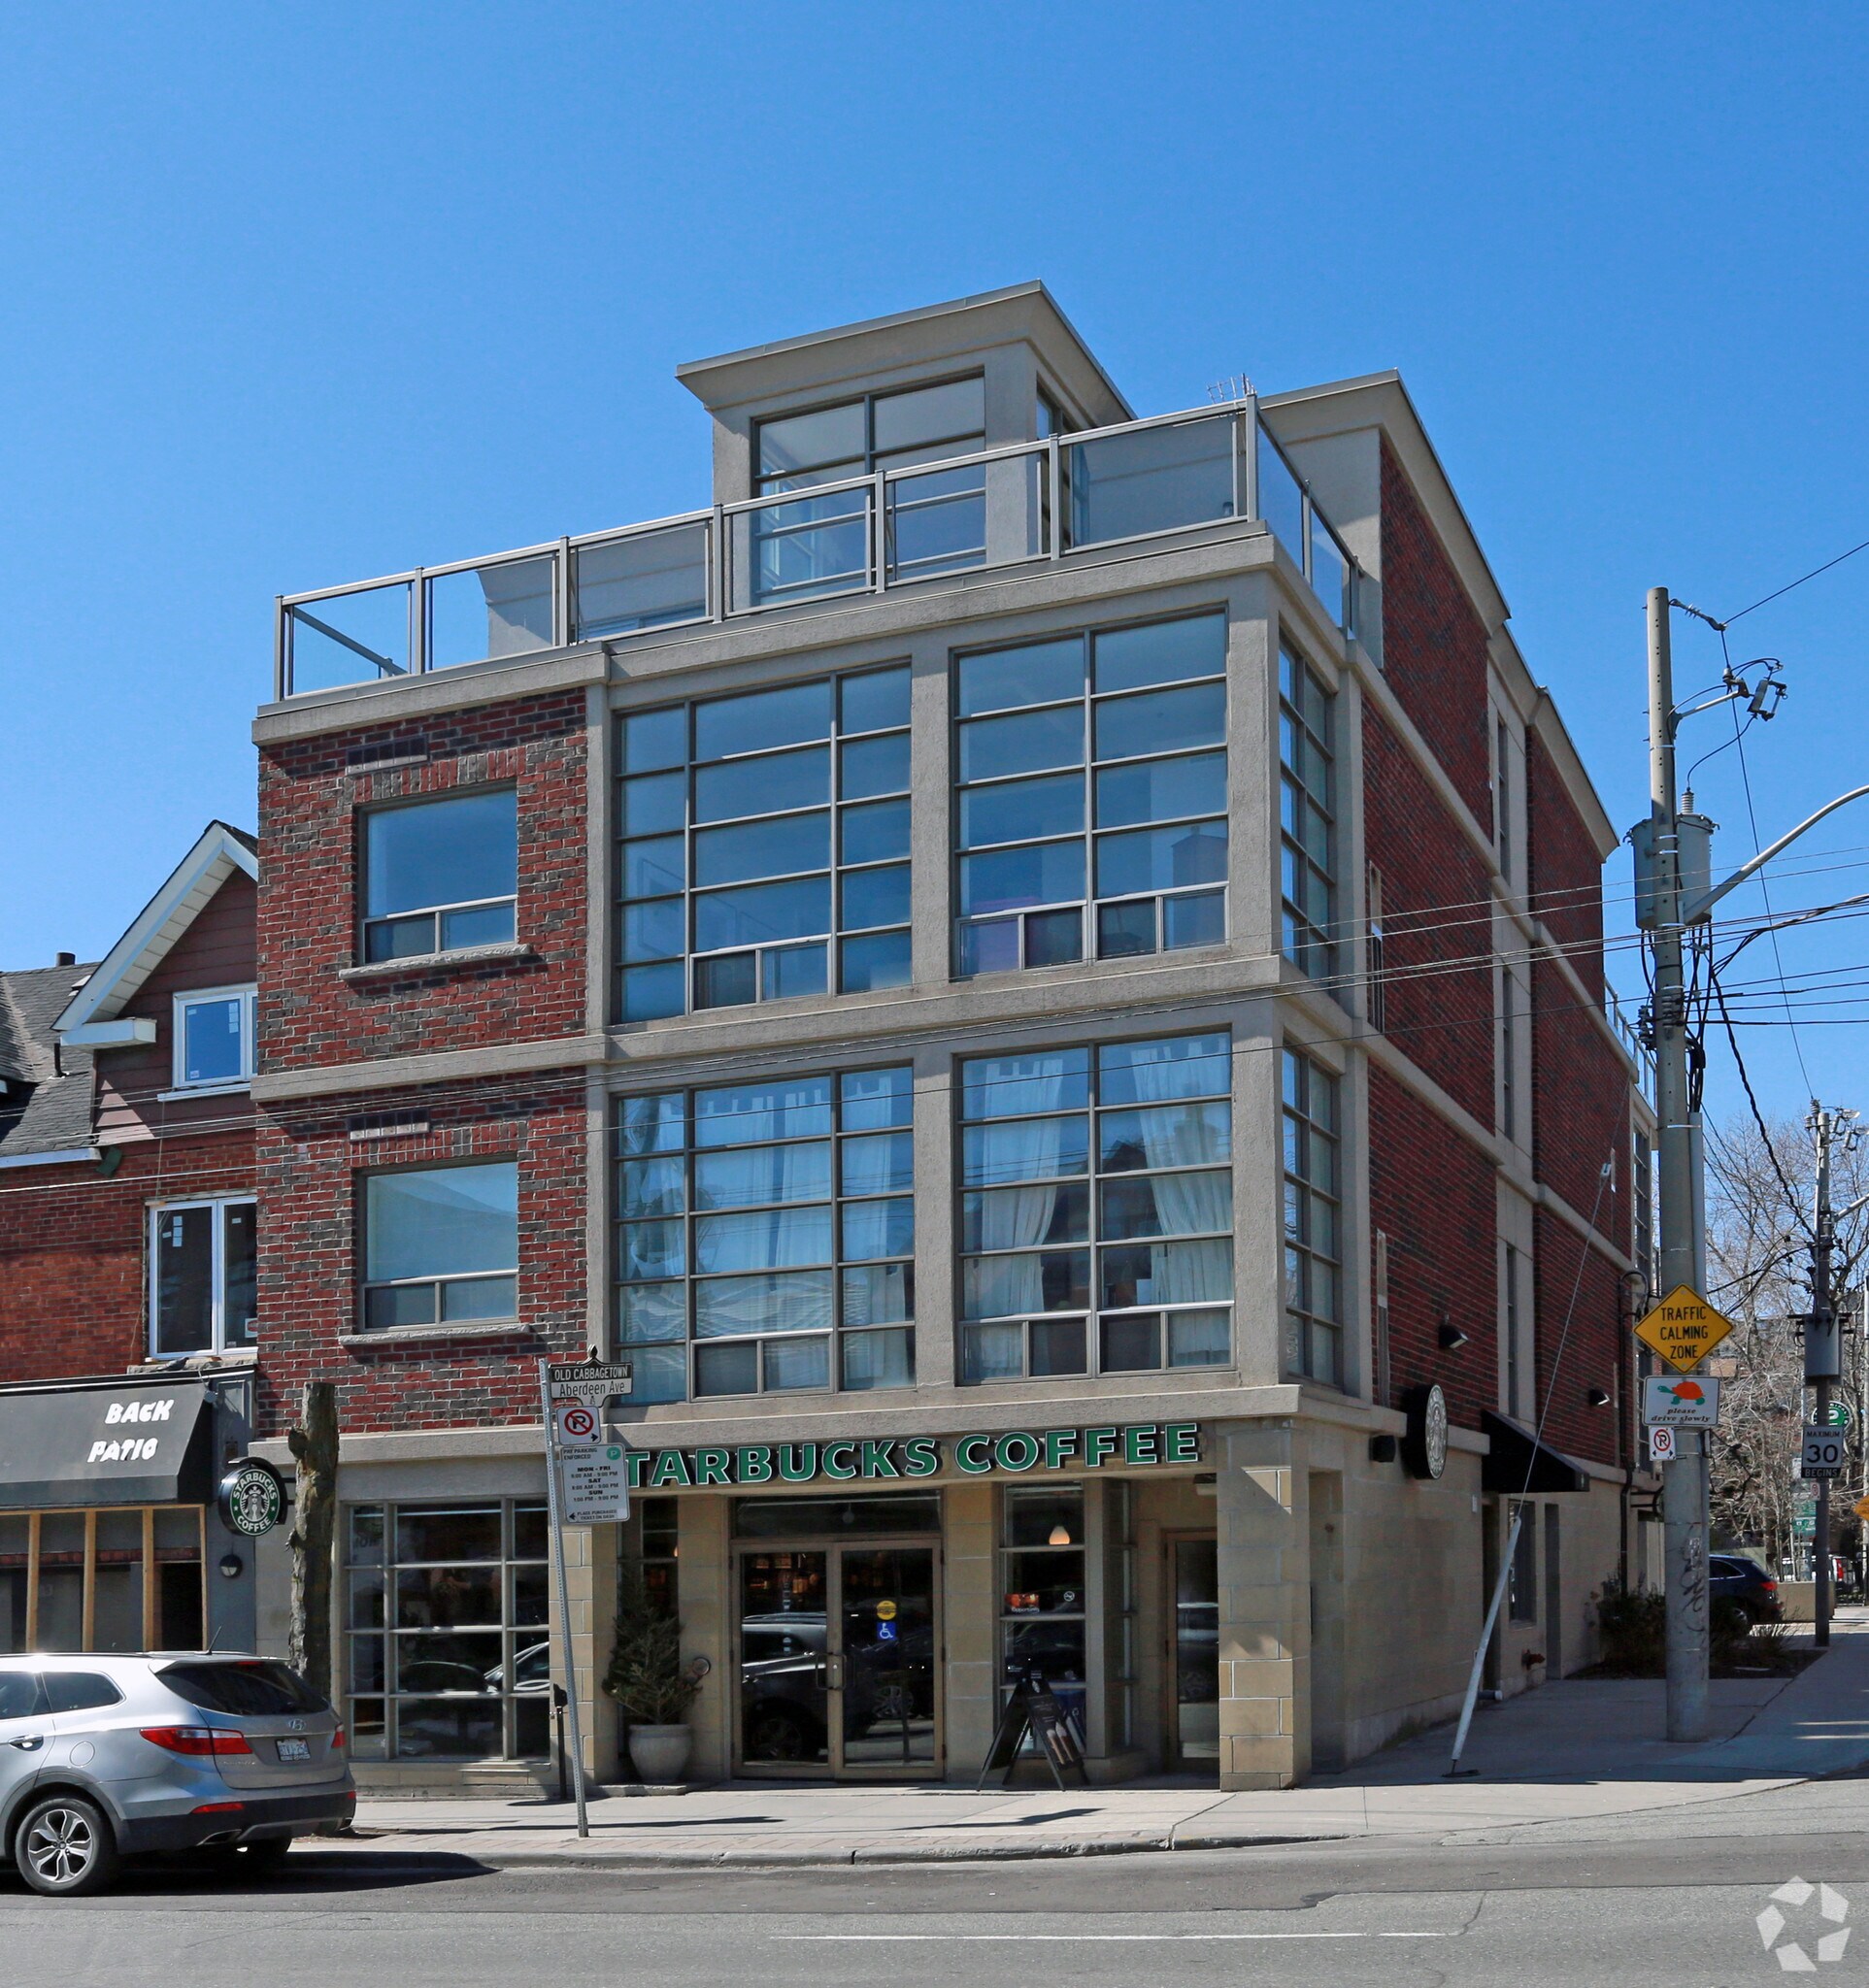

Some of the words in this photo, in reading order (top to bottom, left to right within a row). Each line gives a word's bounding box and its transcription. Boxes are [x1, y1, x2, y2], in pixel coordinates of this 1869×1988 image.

[1661, 1307, 1707, 1320] TRAFFIC
[1660, 1326, 1709, 1340] CALMING
[1670, 1345, 1698, 1359] ZONE
[554, 1369, 571, 1381] OLD
[573, 1366, 628, 1380] CABBAGETOWN
[559, 1382, 606, 1397] Aberdeen
[609, 1380, 625, 1394] Ave
[104, 1399, 175, 1424] BACK
[86, 1438, 158, 1463] PATIO
[625, 1437, 938, 1488] TARBUCKS
[954, 1423, 1199, 1474] COFFEE
[1807, 1444, 1839, 1464] 30
[1805, 1468, 1838, 1477] BEGINS
[233, 1472, 278, 1500] STARBUCKS
[237, 1515, 271, 1532] COFFEE
